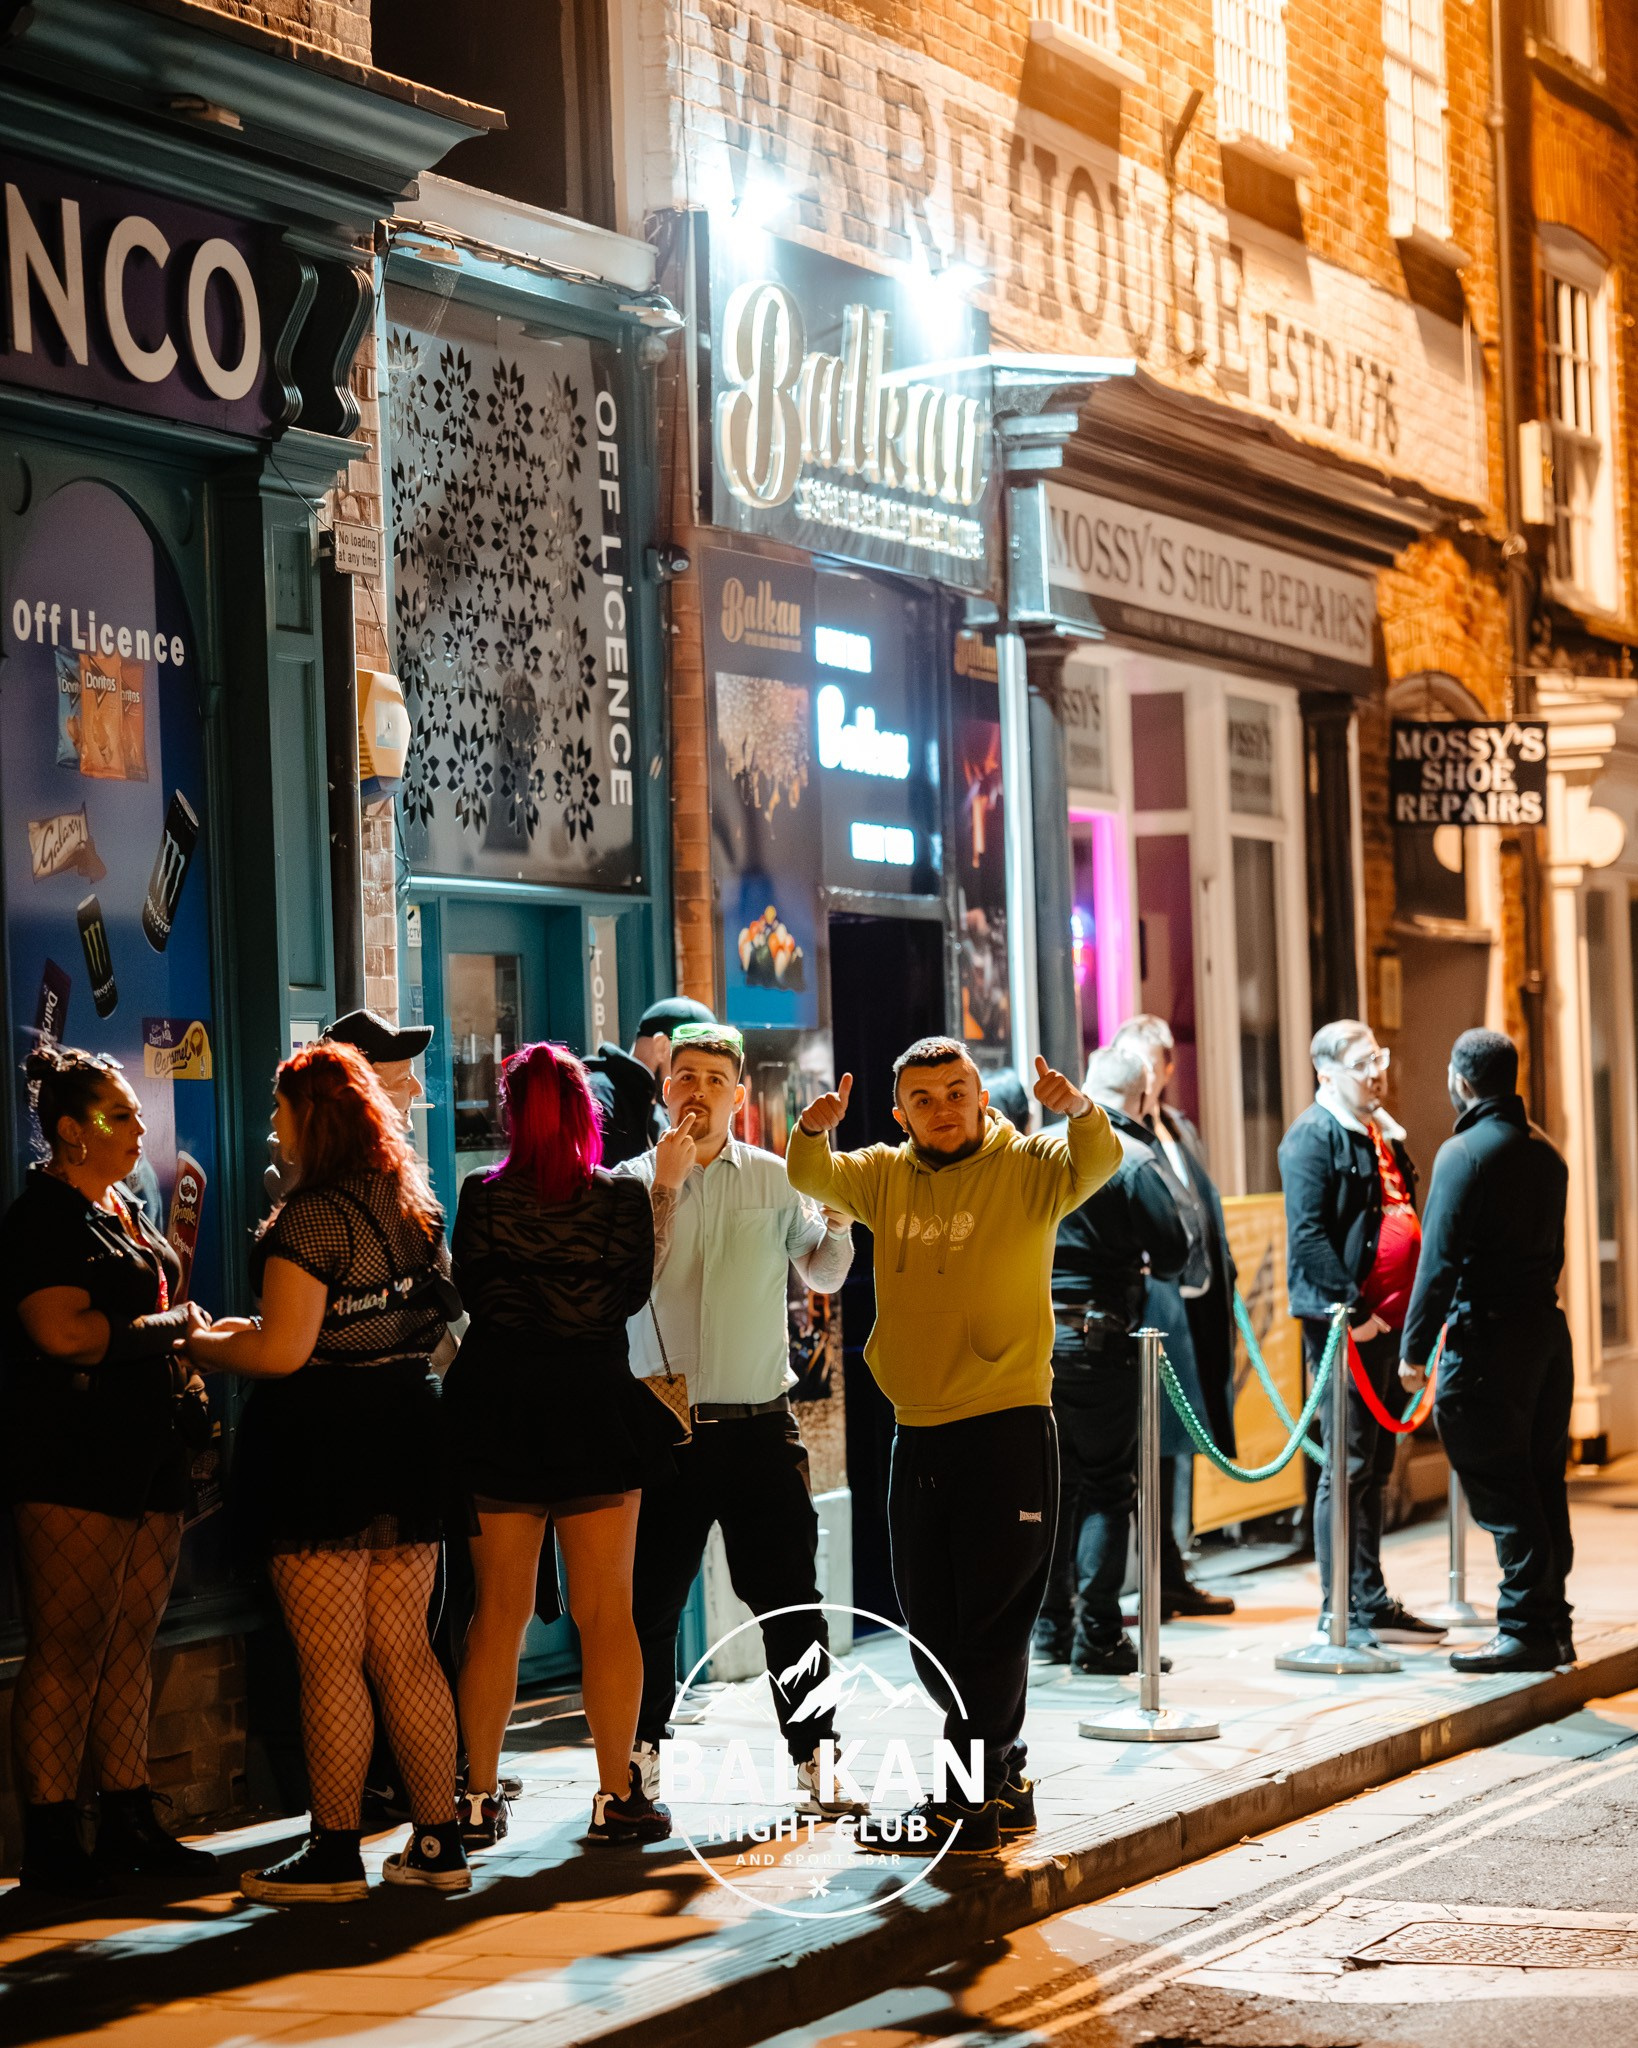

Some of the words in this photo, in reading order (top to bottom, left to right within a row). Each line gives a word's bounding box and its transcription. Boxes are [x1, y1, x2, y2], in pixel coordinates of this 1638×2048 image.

[698, 0, 1250, 402] WAREHOUSE
[5, 182, 261, 400] NCO
[595, 391, 621, 515] OFF
[338, 530, 349, 545] No
[350, 533, 376, 553] loading
[338, 550, 346, 562] at
[348, 552, 360, 567] any
[361, 553, 377, 568] time
[1049, 506, 1176, 597] MOSSY'S
[1181, 545, 1253, 618] SHOE
[1260, 568, 1367, 650] REPAIRS
[12, 599, 61, 645] Off
[70, 612, 186, 667] Licence
[720, 577, 801, 643] Balkan
[86, 671, 117, 692] Doritos
[600, 540, 634, 807] LICENCE
[1395, 727, 1546, 763] MOSSY'S
[1421, 759, 1518, 793] SHOE
[1397, 792, 1545, 826] REPAIRS
[41, 817, 84, 870] Galaxy
